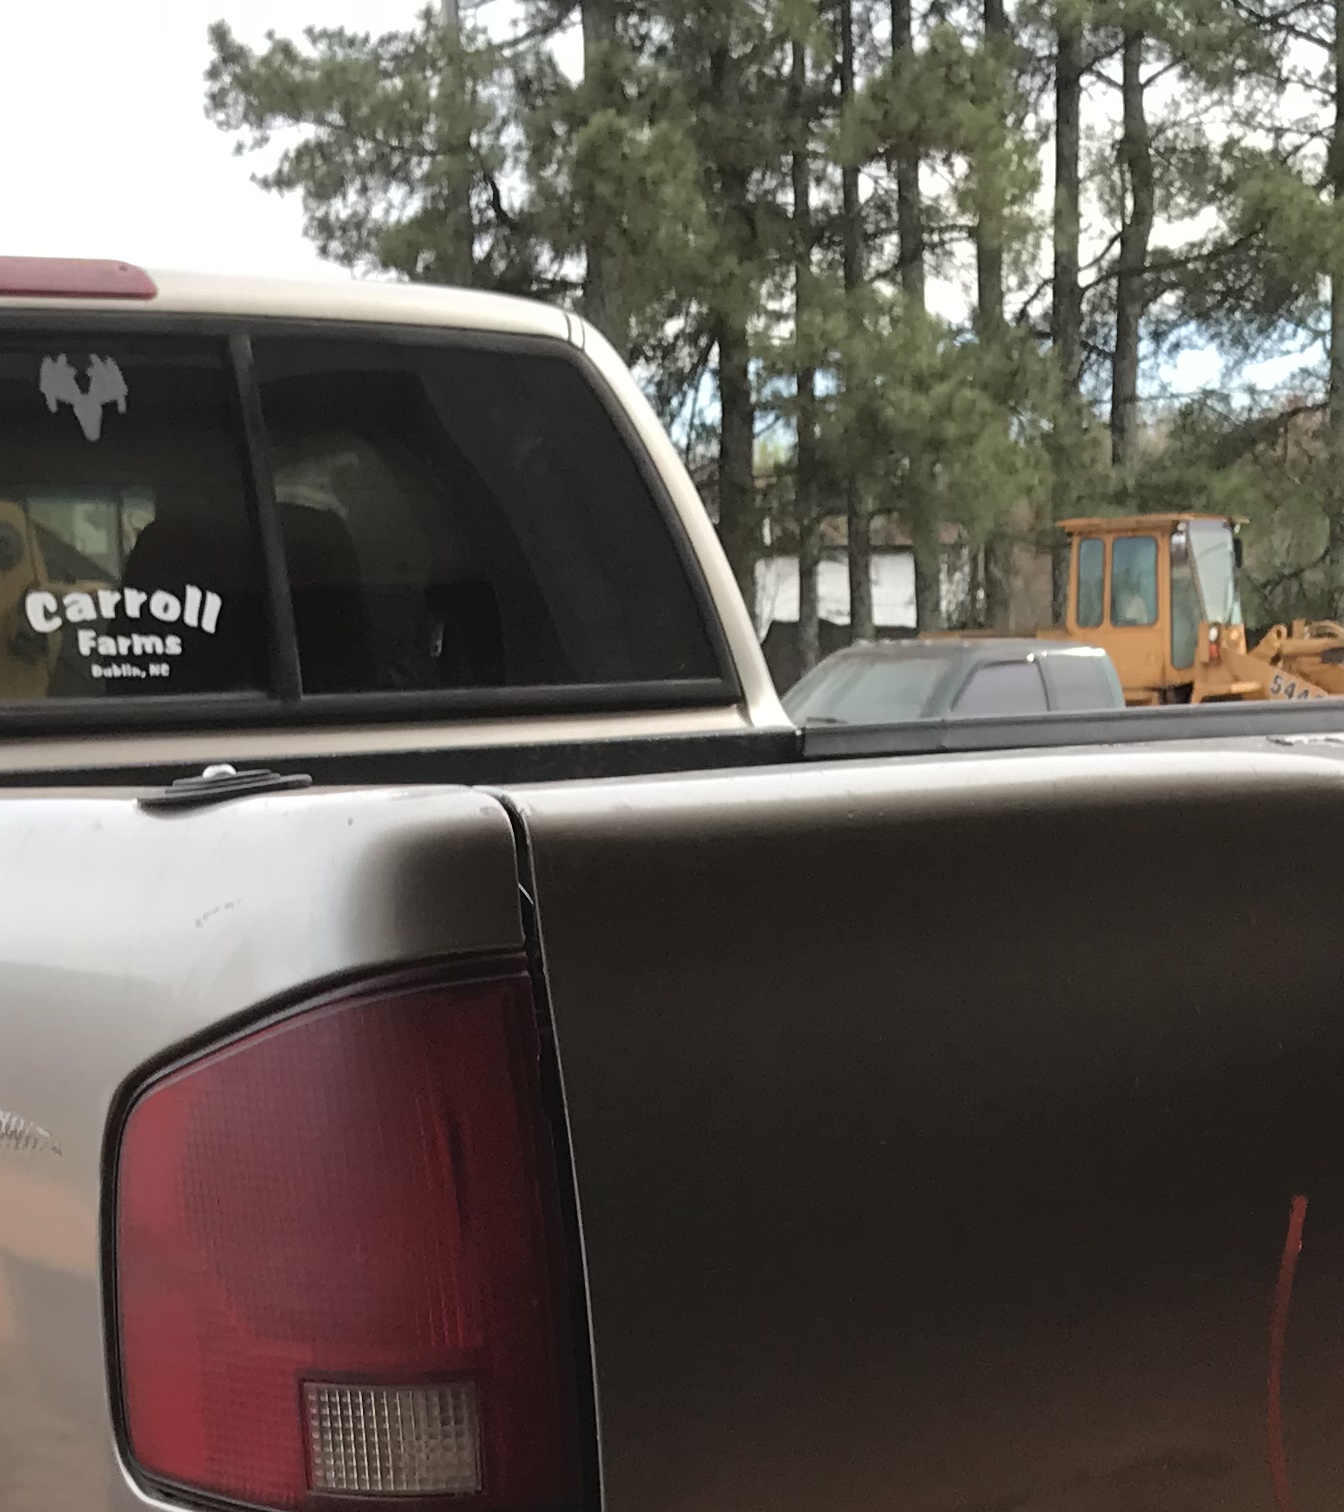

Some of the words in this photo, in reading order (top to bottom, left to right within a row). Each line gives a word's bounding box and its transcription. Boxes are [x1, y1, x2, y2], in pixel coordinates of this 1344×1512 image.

[25, 583, 222, 634] Carroll
[77, 628, 182, 656] Farms
[91, 663, 146, 678] Dublin,
[148, 662, 170, 677] NC
